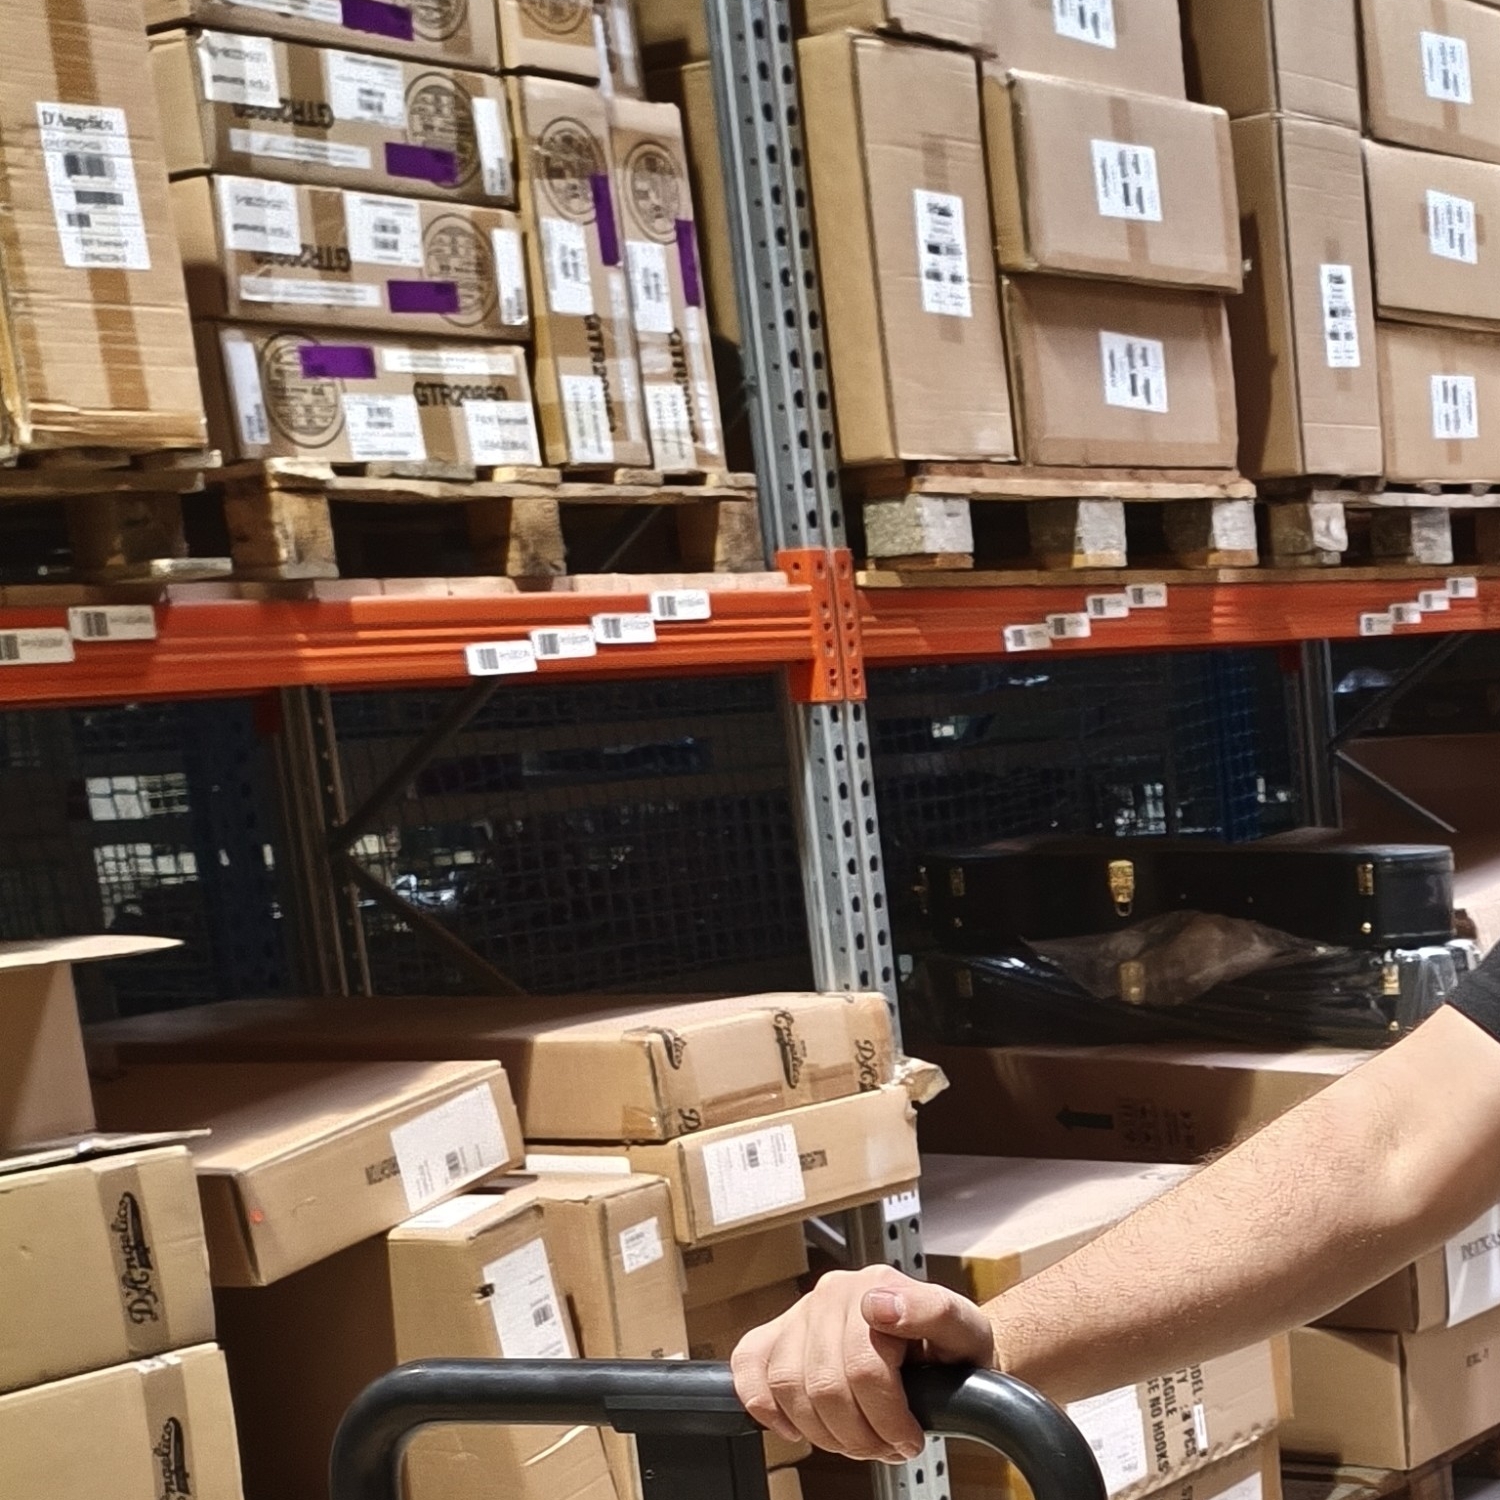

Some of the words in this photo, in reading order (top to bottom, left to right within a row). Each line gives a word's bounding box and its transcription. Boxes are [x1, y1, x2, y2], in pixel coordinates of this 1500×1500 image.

[110, 1190, 160, 1325] D'Angelico
[1149, 1398, 1163, 1419] NO
[1161, 1376, 1179, 1418] AGILE
[1152, 1421, 1171, 1474] HOOKS
